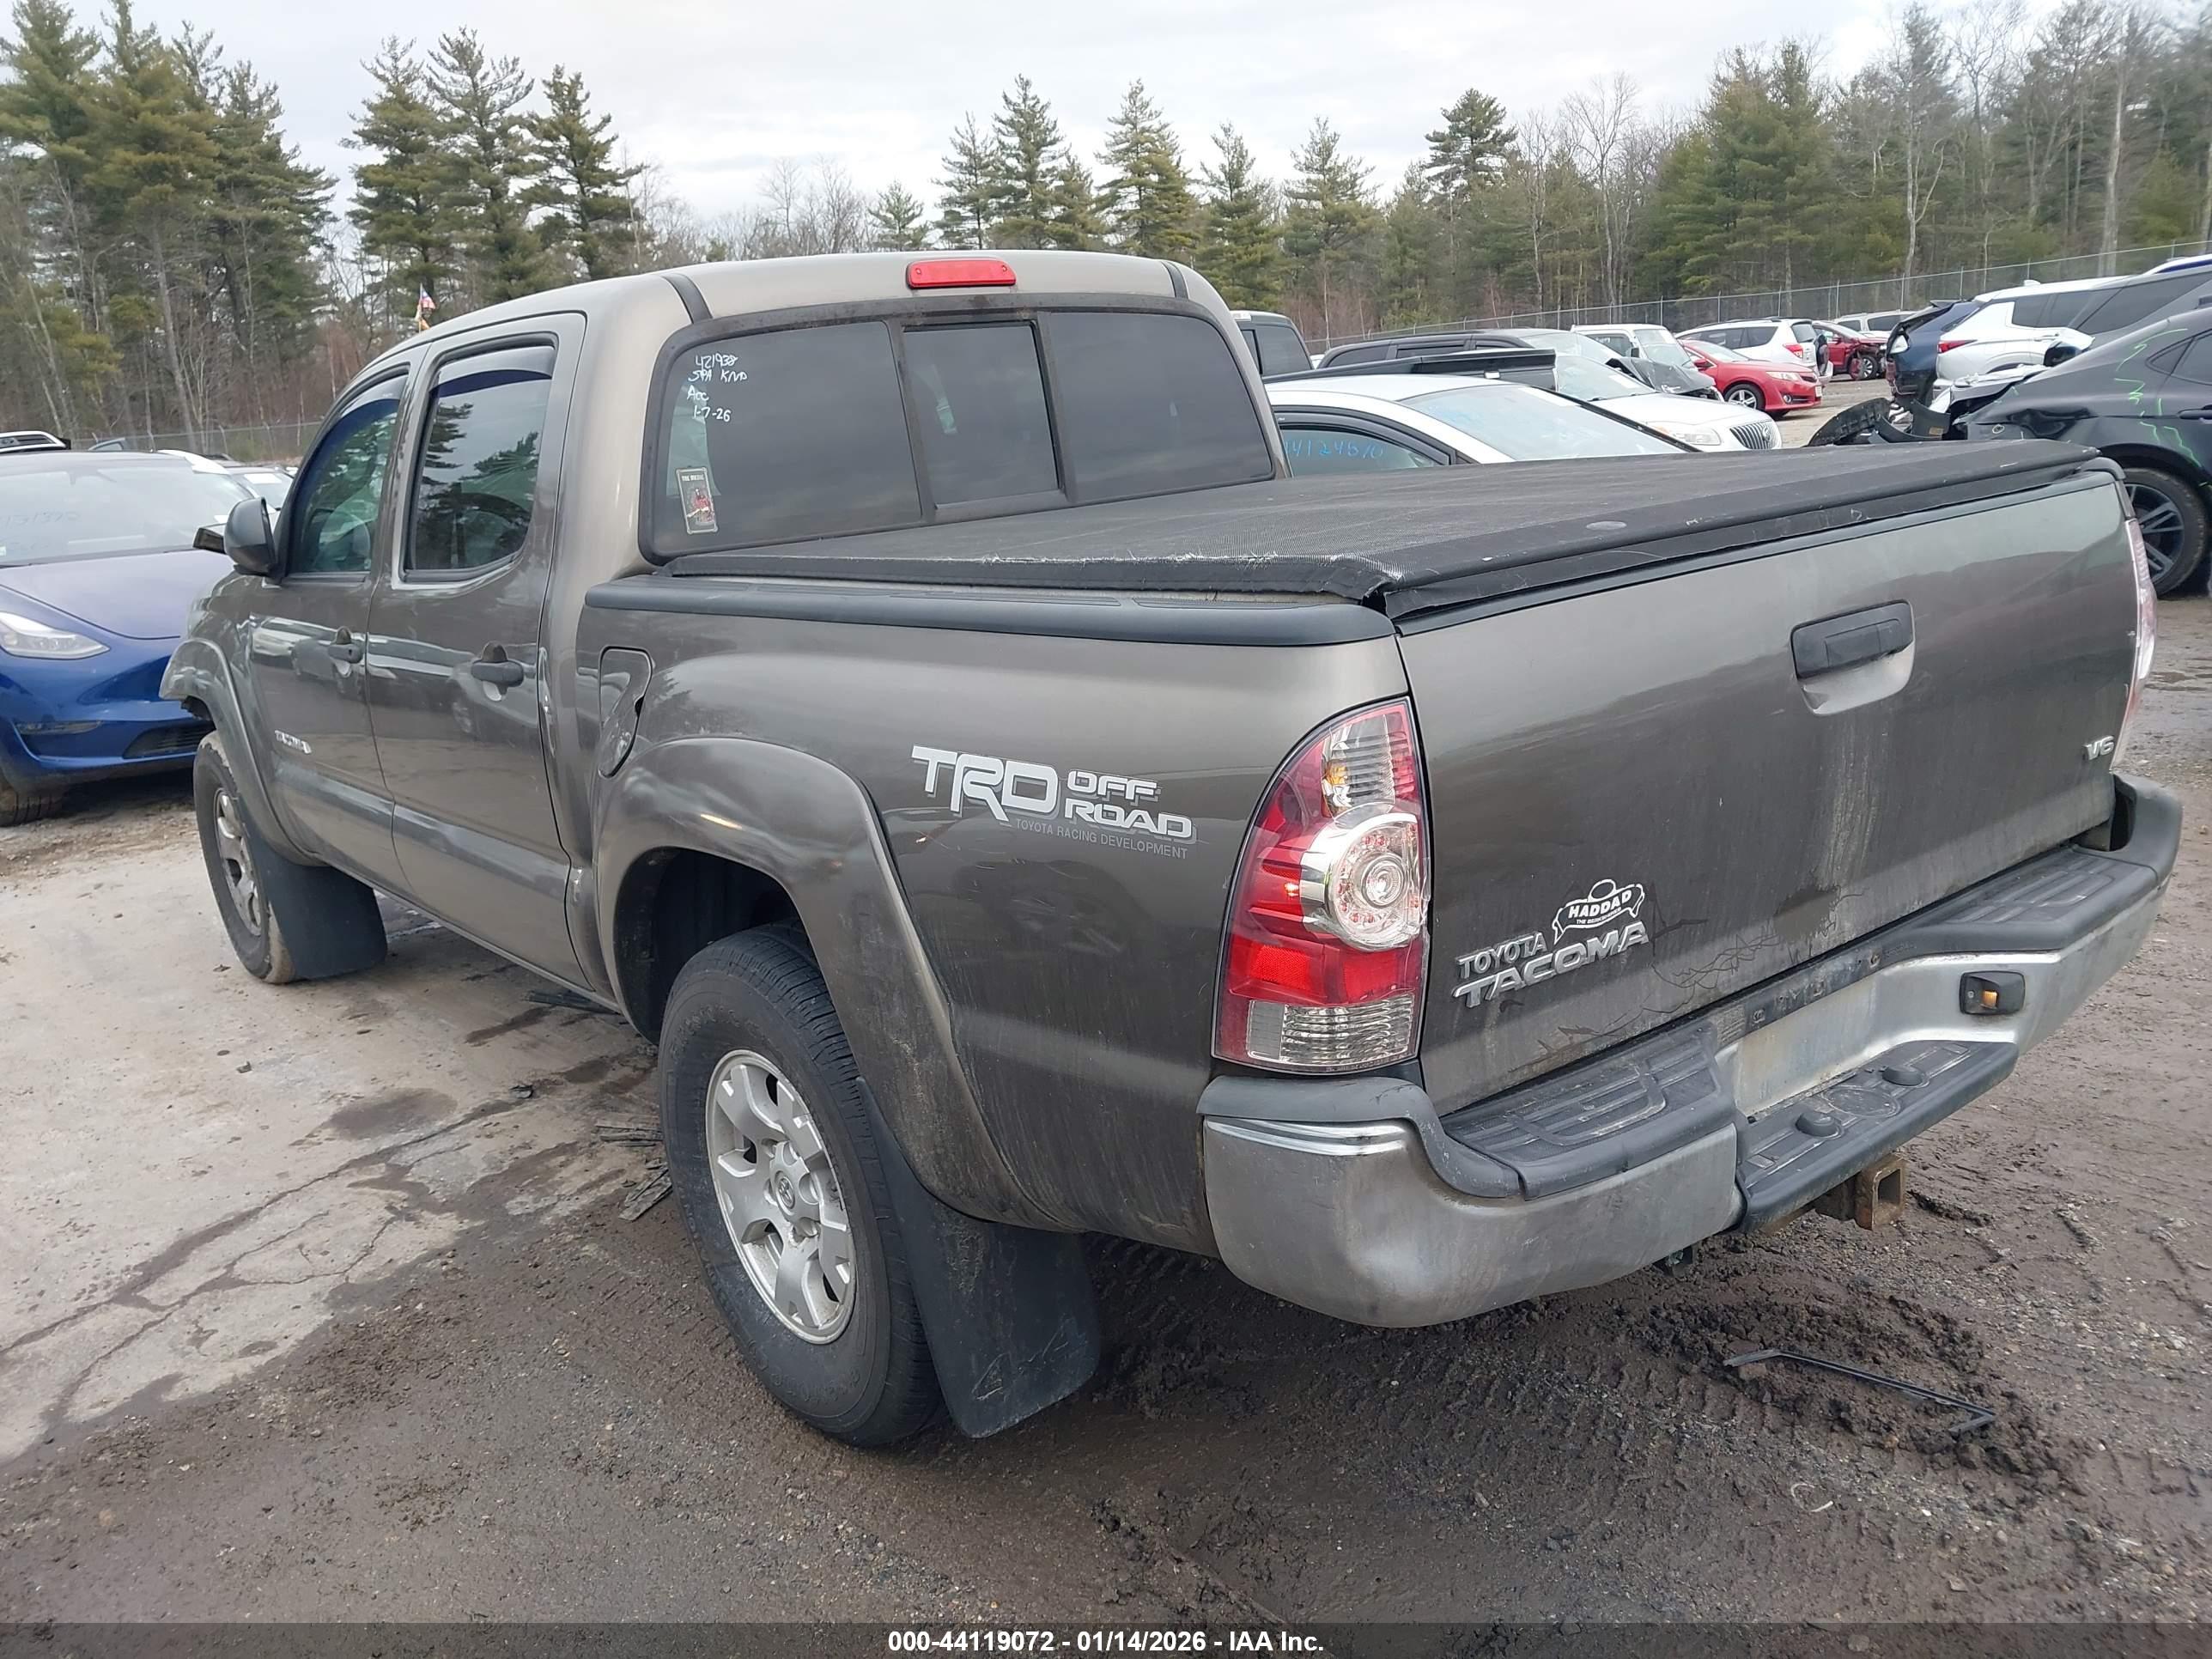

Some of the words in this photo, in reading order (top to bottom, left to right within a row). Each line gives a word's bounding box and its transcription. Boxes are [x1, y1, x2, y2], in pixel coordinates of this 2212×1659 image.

[2082, 735, 2115, 761] V6
[911, 744, 1061, 823] TRD
[1066, 769, 1159, 801] OFF
[1015, 818, 1054, 836] TOYOTA
[1056, 827, 1097, 844] RACING
[1100, 835, 1189, 860] DEVELOPMENT
[1064, 797, 1195, 841] ROAD
[1567, 889, 1632, 919] HADDAD
[1451, 921, 1650, 1009] TACOMA
[1455, 931, 1548, 980] TOYOTA
